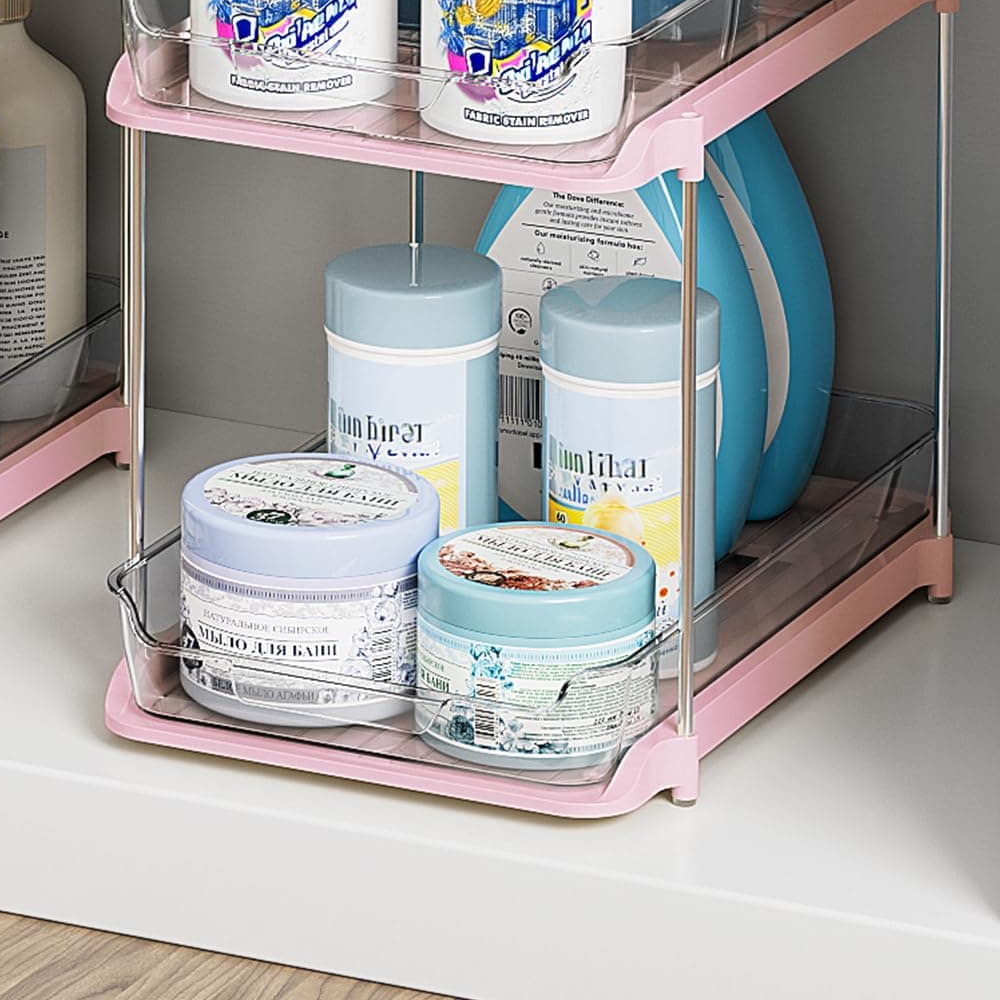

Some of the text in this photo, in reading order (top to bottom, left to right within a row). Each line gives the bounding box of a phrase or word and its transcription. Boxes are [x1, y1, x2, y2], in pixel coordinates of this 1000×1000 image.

[303, 74, 353, 93] REMOVER
[464, 107, 500, 126] FABRIC
[538, 108, 589, 128] REMOVER
[553, 192, 566, 200] The
[567, 194, 584, 202] Dove
[534, 229, 548, 238] Our
[550, 231, 595, 245] moisturizing
[597, 237, 626, 248] formula
[199, 624, 248, 652] МЫЛО
[251, 641, 287, 657] ДЛЯ
